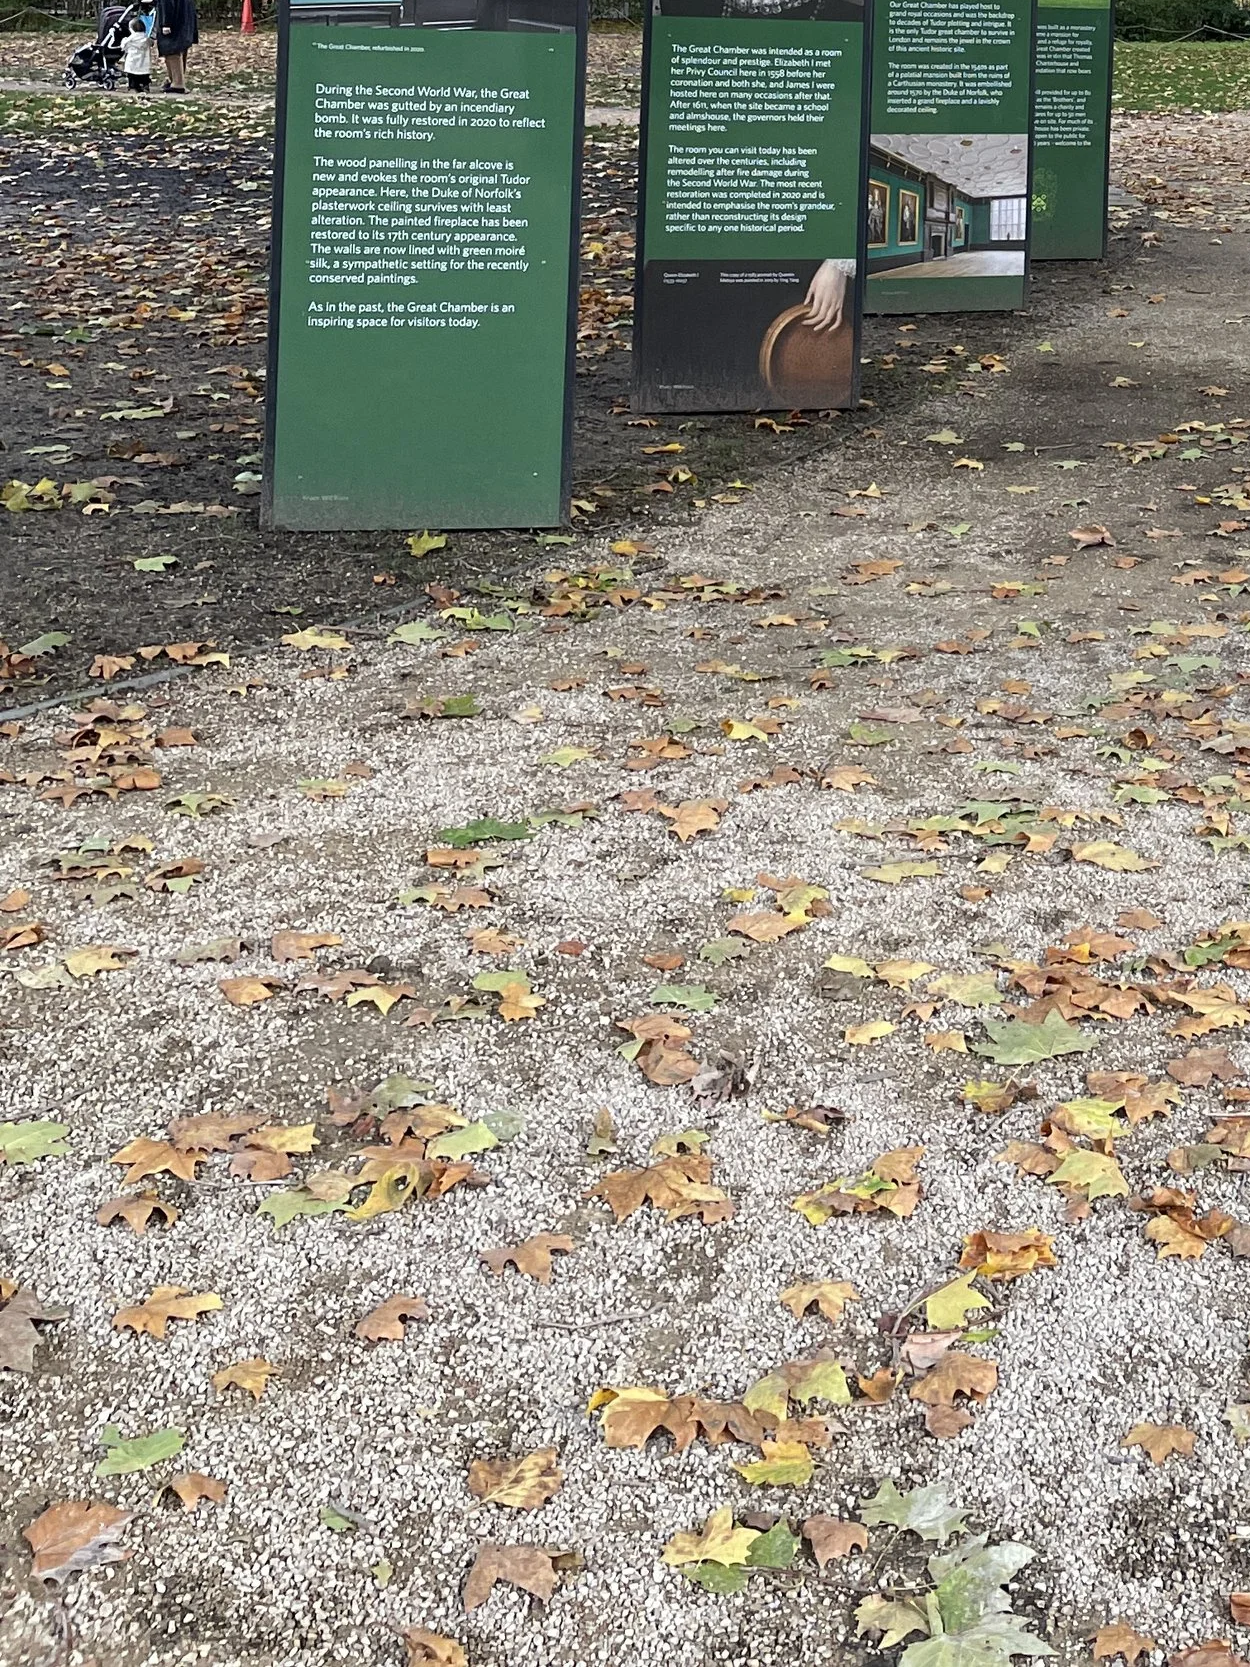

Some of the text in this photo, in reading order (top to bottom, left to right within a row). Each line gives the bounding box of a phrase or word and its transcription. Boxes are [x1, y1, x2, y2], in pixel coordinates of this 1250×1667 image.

[672, 44, 687, 53] The
[688, 44, 711, 53] Great
[713, 45, 750, 54] Chamber
[768, 47, 803, 56] intended
[671, 55, 680, 63] of
[681, 56, 721, 65] splendour
[722, 57, 738, 65] and
[739, 58, 773, 67] prestige.
[774, 58, 810, 67] Elizabeth
[811, 58, 814, 66] I
[671, 66, 684, 75] her
[686, 66, 706, 77] Privy
[707, 67, 737, 76] Council
[739, 68, 757, 77] here
[767, 69, 785, 79] 1558
[786, 69, 811, 78] before
[812, 69, 826, 78] her
[316, 83, 529, 99] During the Second World War, the Great
[315, 98, 365, 109] Chamber
[367, 102, 389, 110] was
[391, 100, 426, 112] gutted
[429, 100, 442, 113] by
[460, 102, 515, 115] incendiary
[315, 112, 545, 128] bomb. It was fully restored in 2020 to reflect
[314, 127, 435, 142] the room's rich history.
[308, 301, 515, 314] As in the past, the Great Chamber is an
[308, 315, 480, 329] inspiring space for visitors today.
